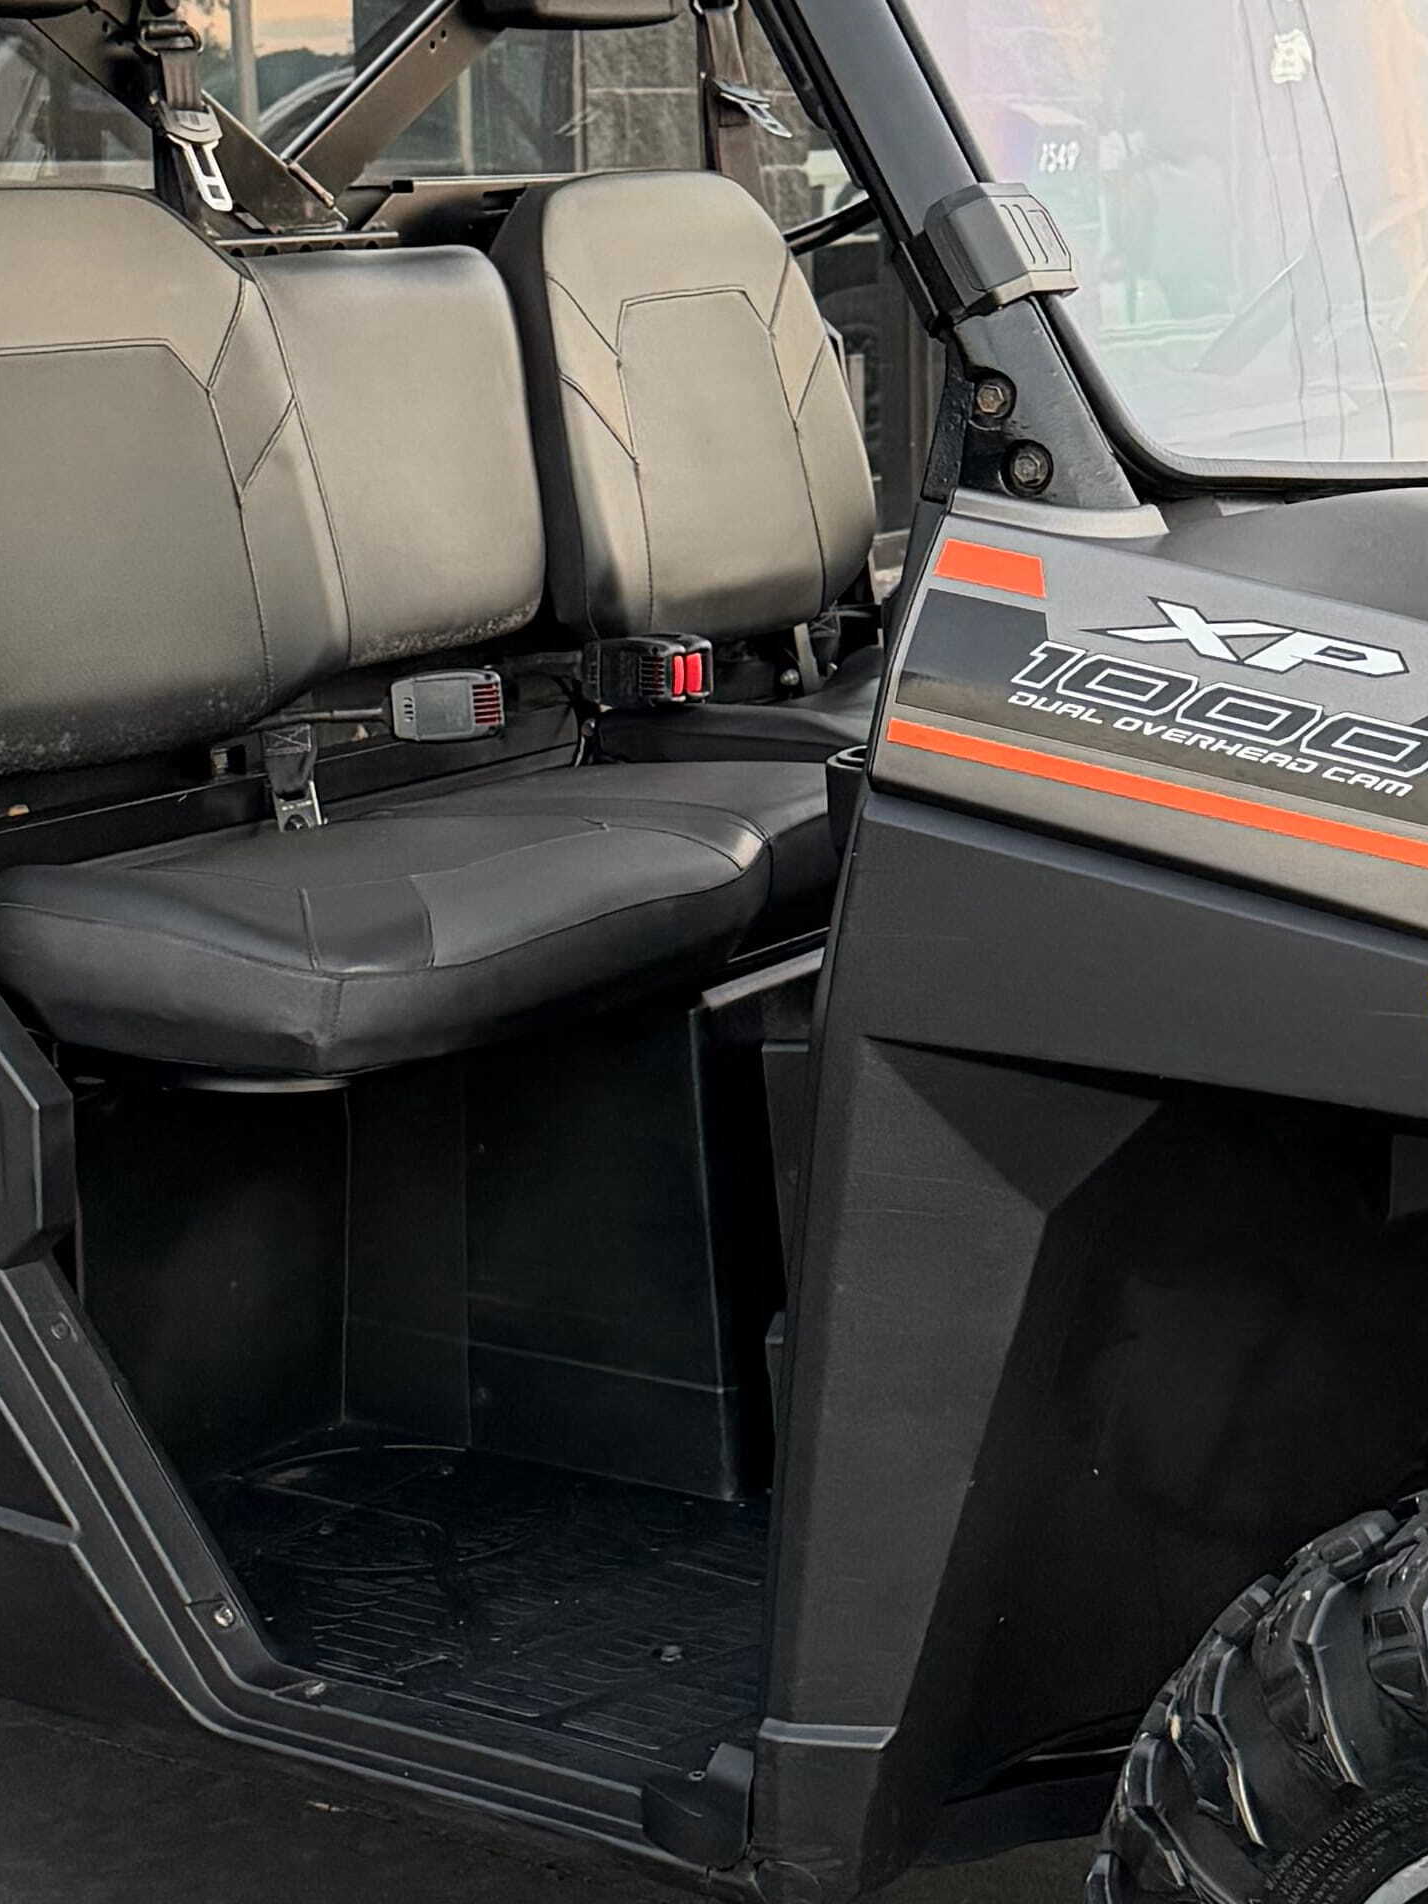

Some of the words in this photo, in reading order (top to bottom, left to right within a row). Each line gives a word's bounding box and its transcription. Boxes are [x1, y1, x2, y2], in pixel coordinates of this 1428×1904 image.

[1098, 597, 1410, 678] XP
[1007, 690, 1104, 725] DUAL
[1112, 716, 1319, 775] OVERHEAD
[1321, 766, 1414, 798] CAM
